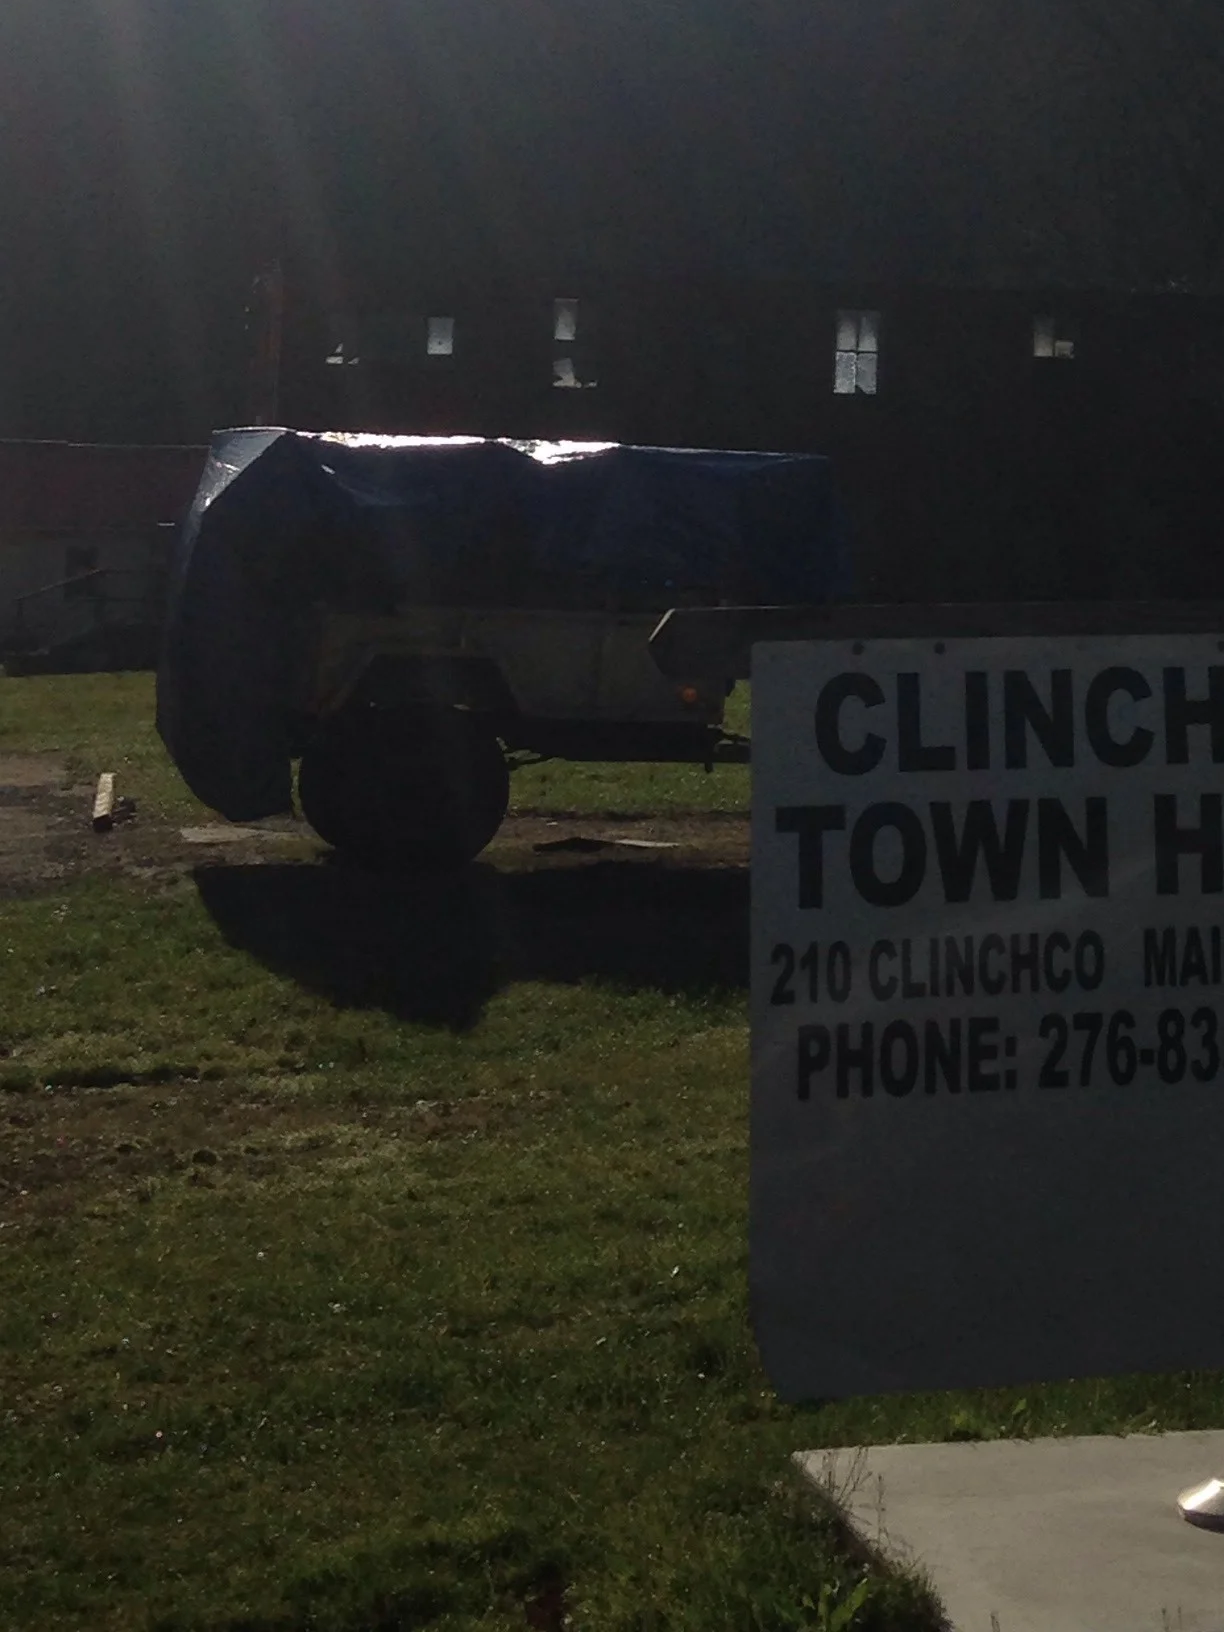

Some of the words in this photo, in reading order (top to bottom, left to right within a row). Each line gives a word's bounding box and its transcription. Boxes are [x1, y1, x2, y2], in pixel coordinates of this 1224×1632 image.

[775, 796, 1109, 909] TOWN
[770, 939, 852, 1005] 210
[868, 930, 1105, 1001] CLINCHCO
[797, 1016, 1017, 1100] PHONE:
